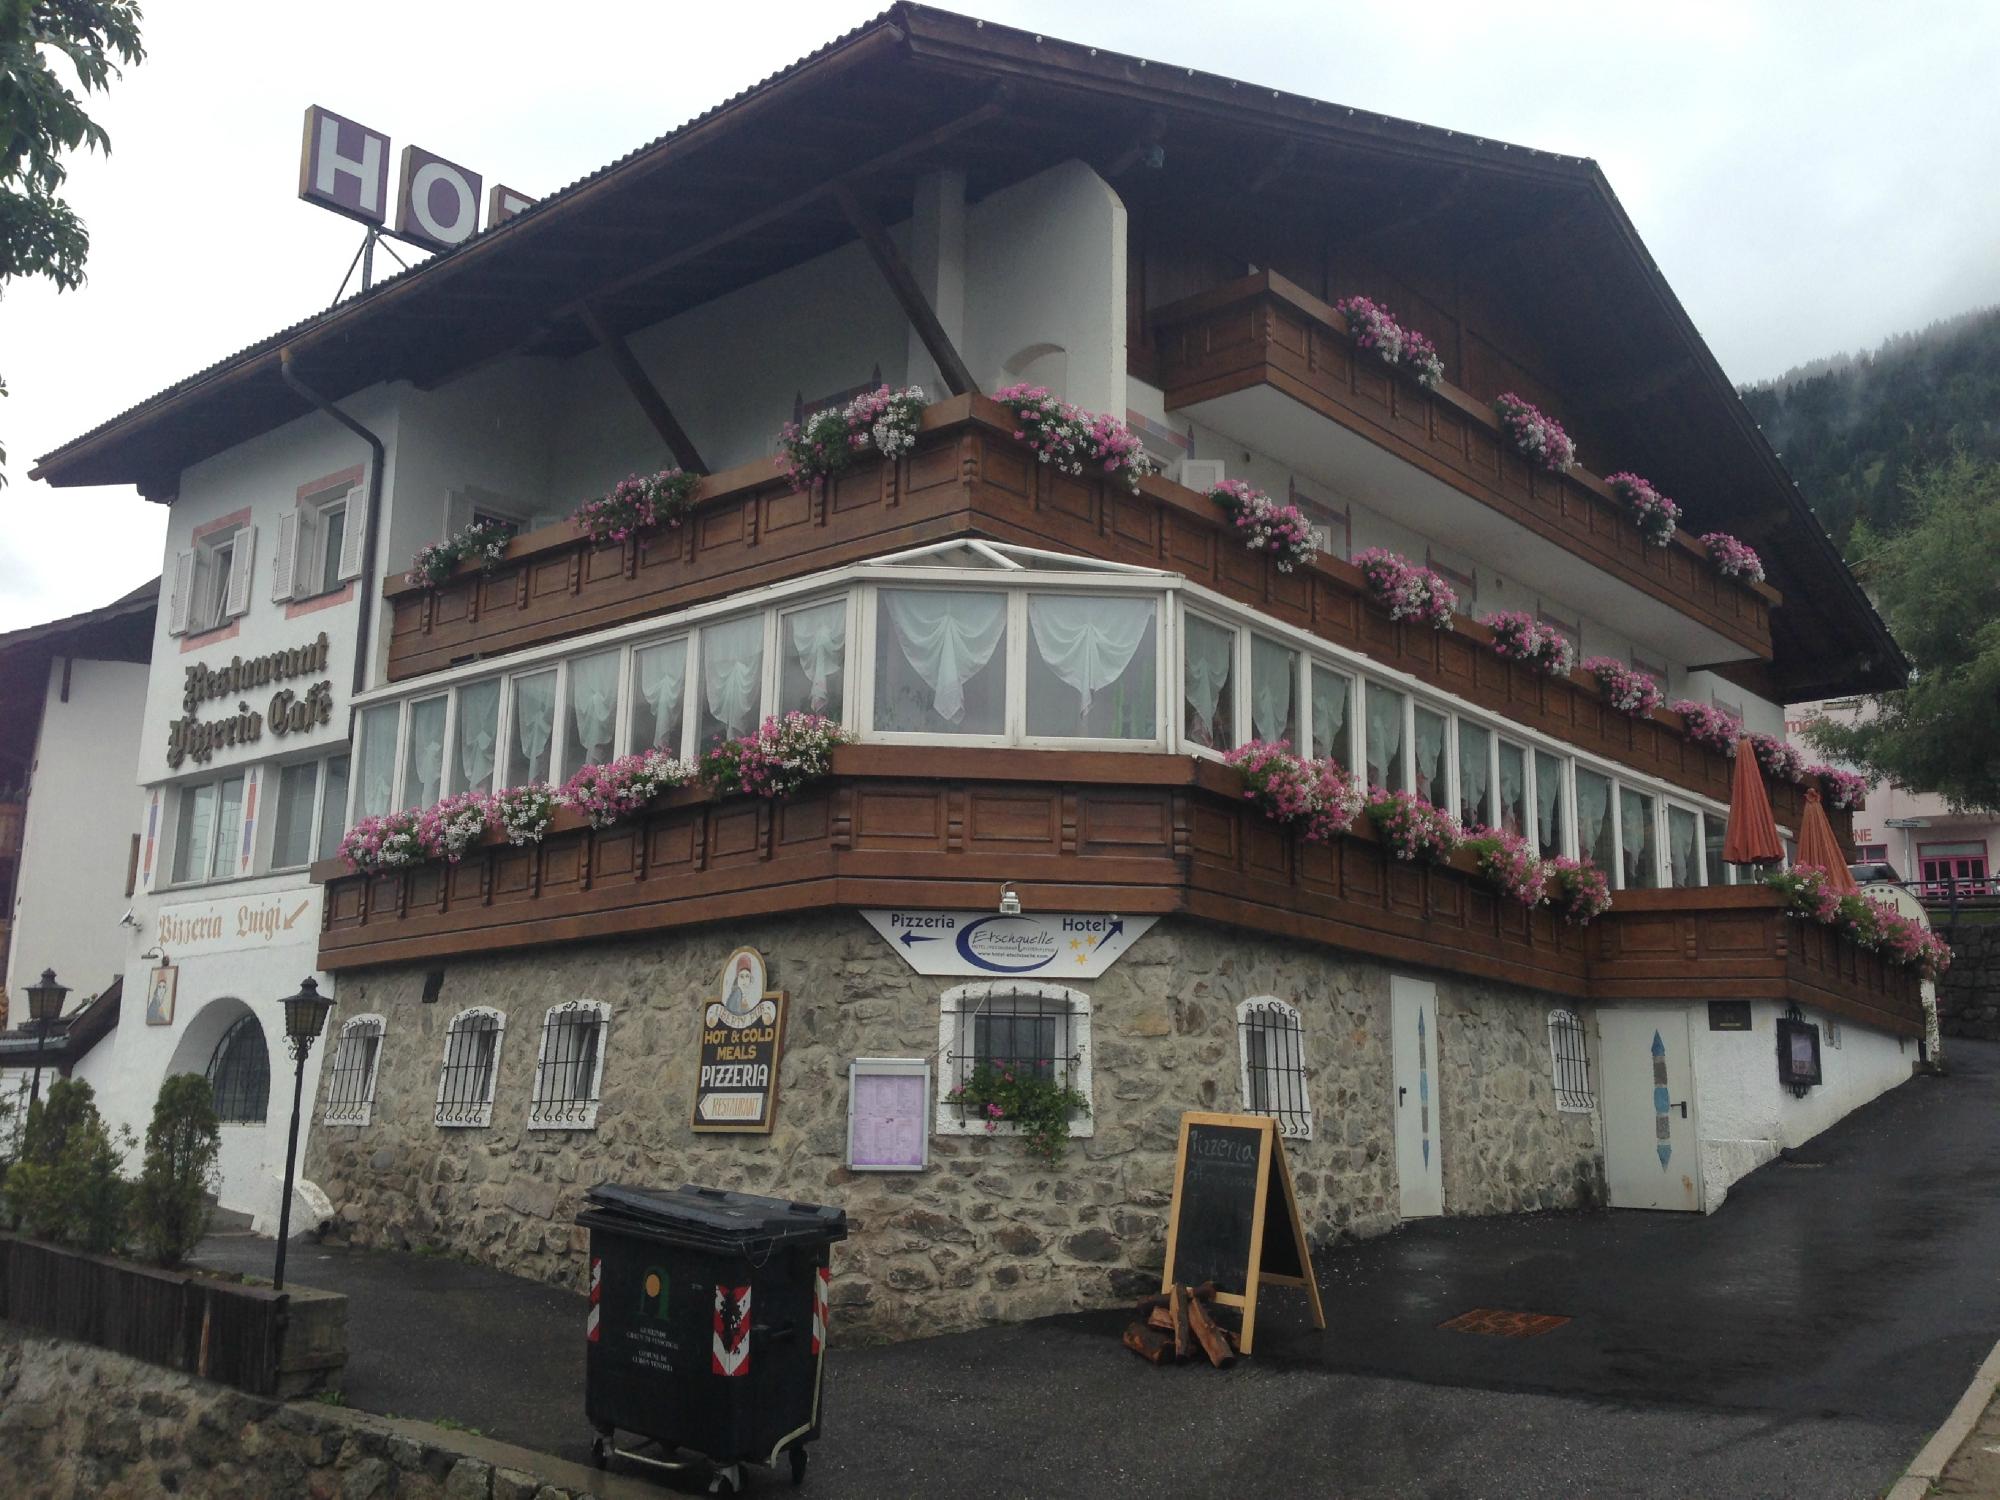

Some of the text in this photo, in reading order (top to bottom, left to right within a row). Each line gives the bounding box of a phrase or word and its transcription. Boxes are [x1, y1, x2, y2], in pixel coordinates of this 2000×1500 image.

[316, 114, 532, 245] HO
[183, 632, 329, 713] Restaurant
[167, 701, 262, 768] Pizzeria
[1851, 828, 1873, 842] NE
[158, 898, 281, 945] Pizzeria Luigi
[891, 913, 955, 929] Pizzeria
[1062, 917, 1106, 932] Hotel
[972, 929, 1055, 952] Etschquelle
[704, 1028, 774, 1045] HOT & COLD
[717, 1045, 757, 1060] MEALS
[700, 1064, 768, 1087] PIZZERIA
[1190, 1130, 1255, 1161] Pizzeria
